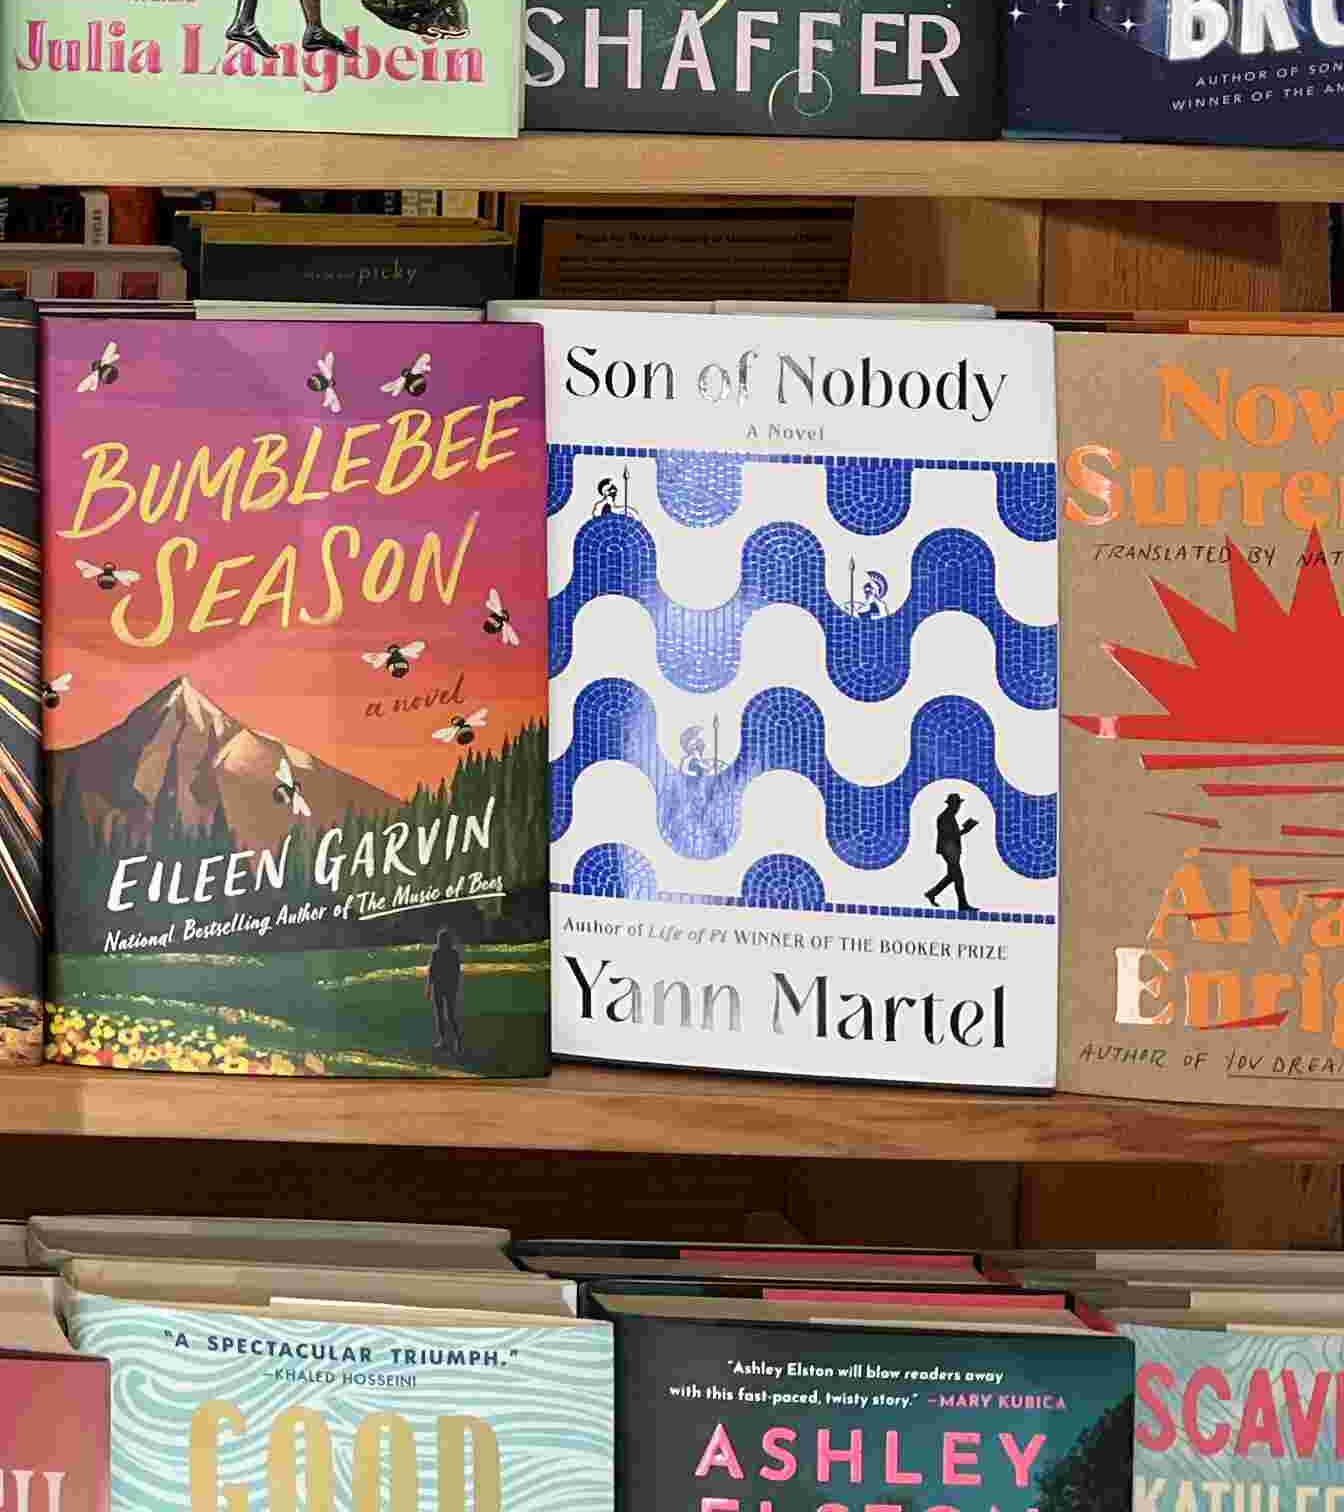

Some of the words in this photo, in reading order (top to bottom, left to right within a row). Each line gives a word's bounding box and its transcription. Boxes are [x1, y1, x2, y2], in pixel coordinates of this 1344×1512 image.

[565, 345, 676, 402] Son
[697, 350, 760, 408] of
[777, 353, 1009, 422] Nobody
[564, 955, 744, 1033] Yann
[769, 971, 1009, 1050] Martel
[207, 1336, 374, 1366] SPECTACULAR
[694, 1422, 1048, 1488] ASHLEY
